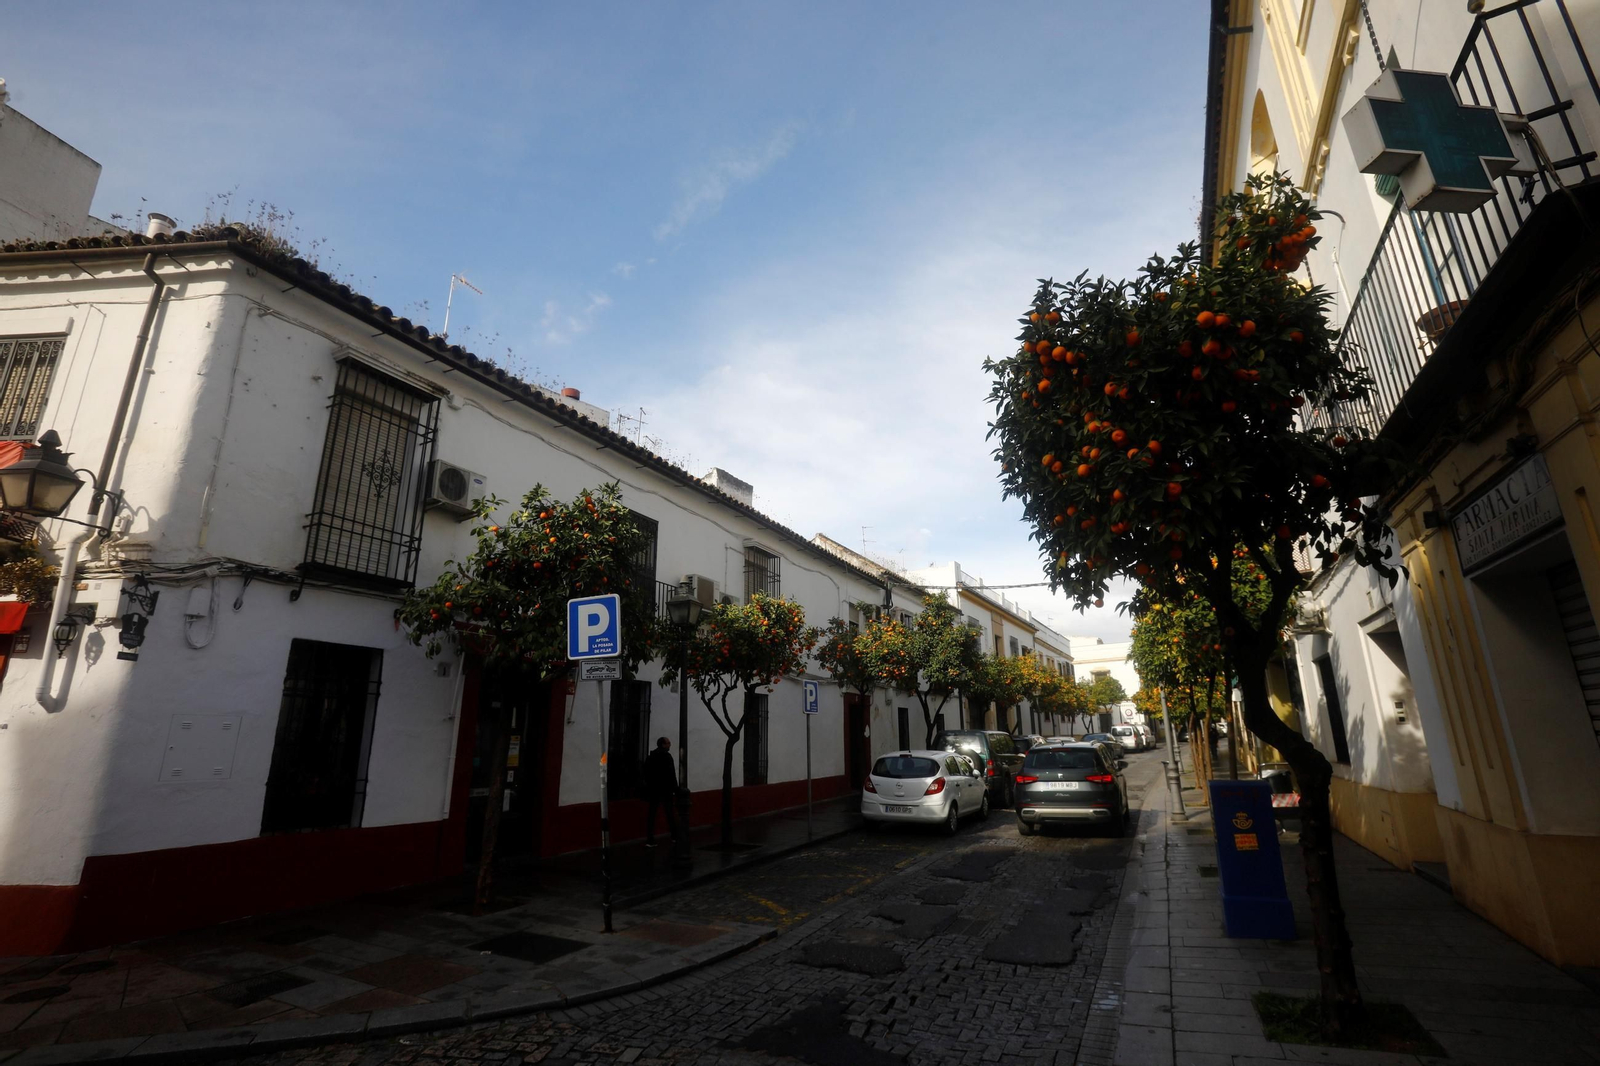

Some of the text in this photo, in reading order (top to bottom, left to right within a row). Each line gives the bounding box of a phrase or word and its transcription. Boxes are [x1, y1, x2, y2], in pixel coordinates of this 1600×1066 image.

[1453, 457, 1550, 541] FARMACIA
[1468, 497, 1540, 553] SANTA MARINA
[578, 603, 610, 652] P
[806, 684, 816, 710] P
